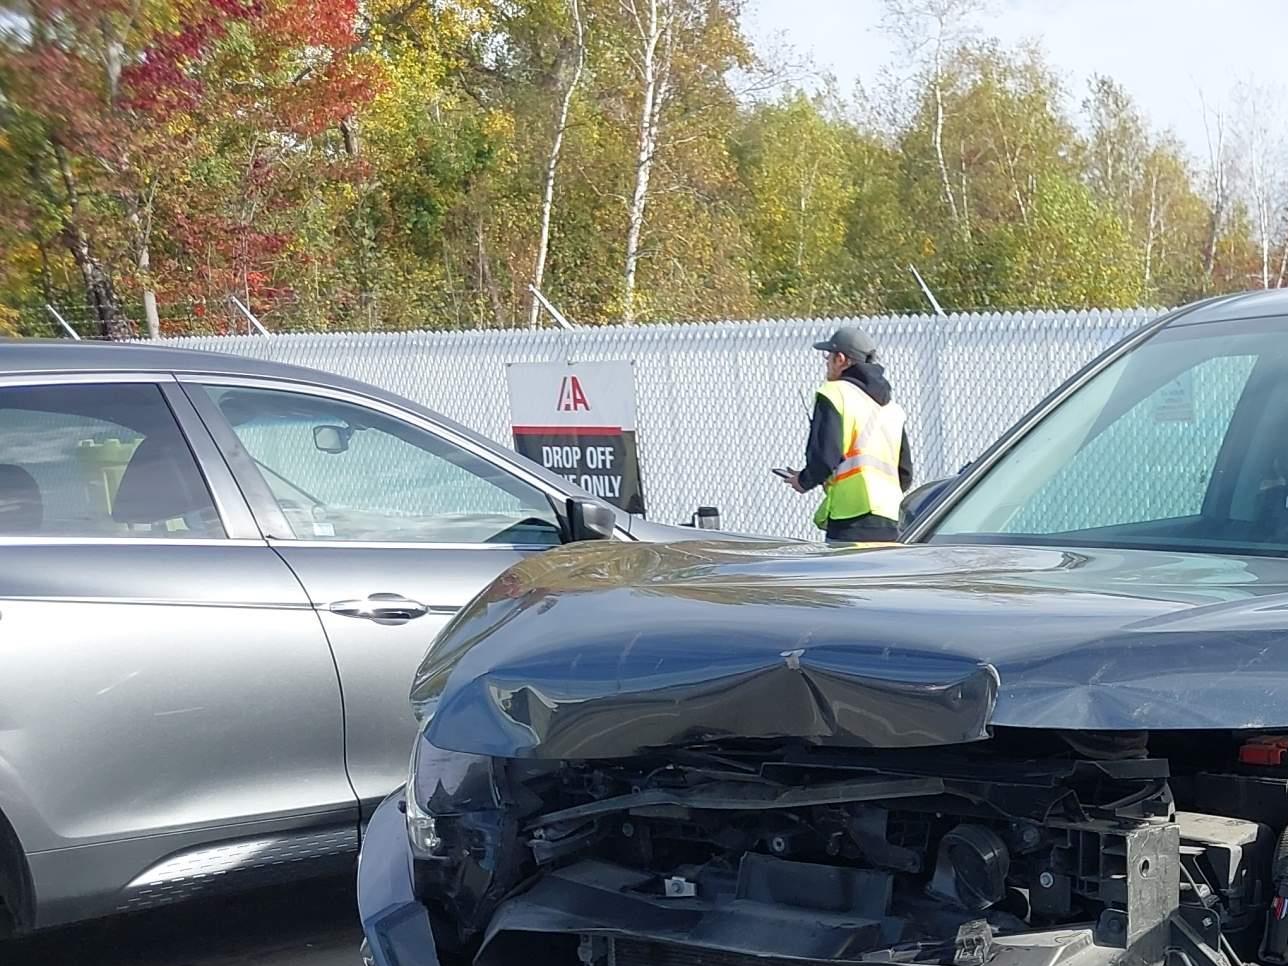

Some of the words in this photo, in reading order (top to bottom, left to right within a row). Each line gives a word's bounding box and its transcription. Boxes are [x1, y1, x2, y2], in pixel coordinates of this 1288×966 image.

[541, 446, 582, 468] DROP
[586, 446, 614, 469] OFF
[580, 474, 622, 498] ONLY
